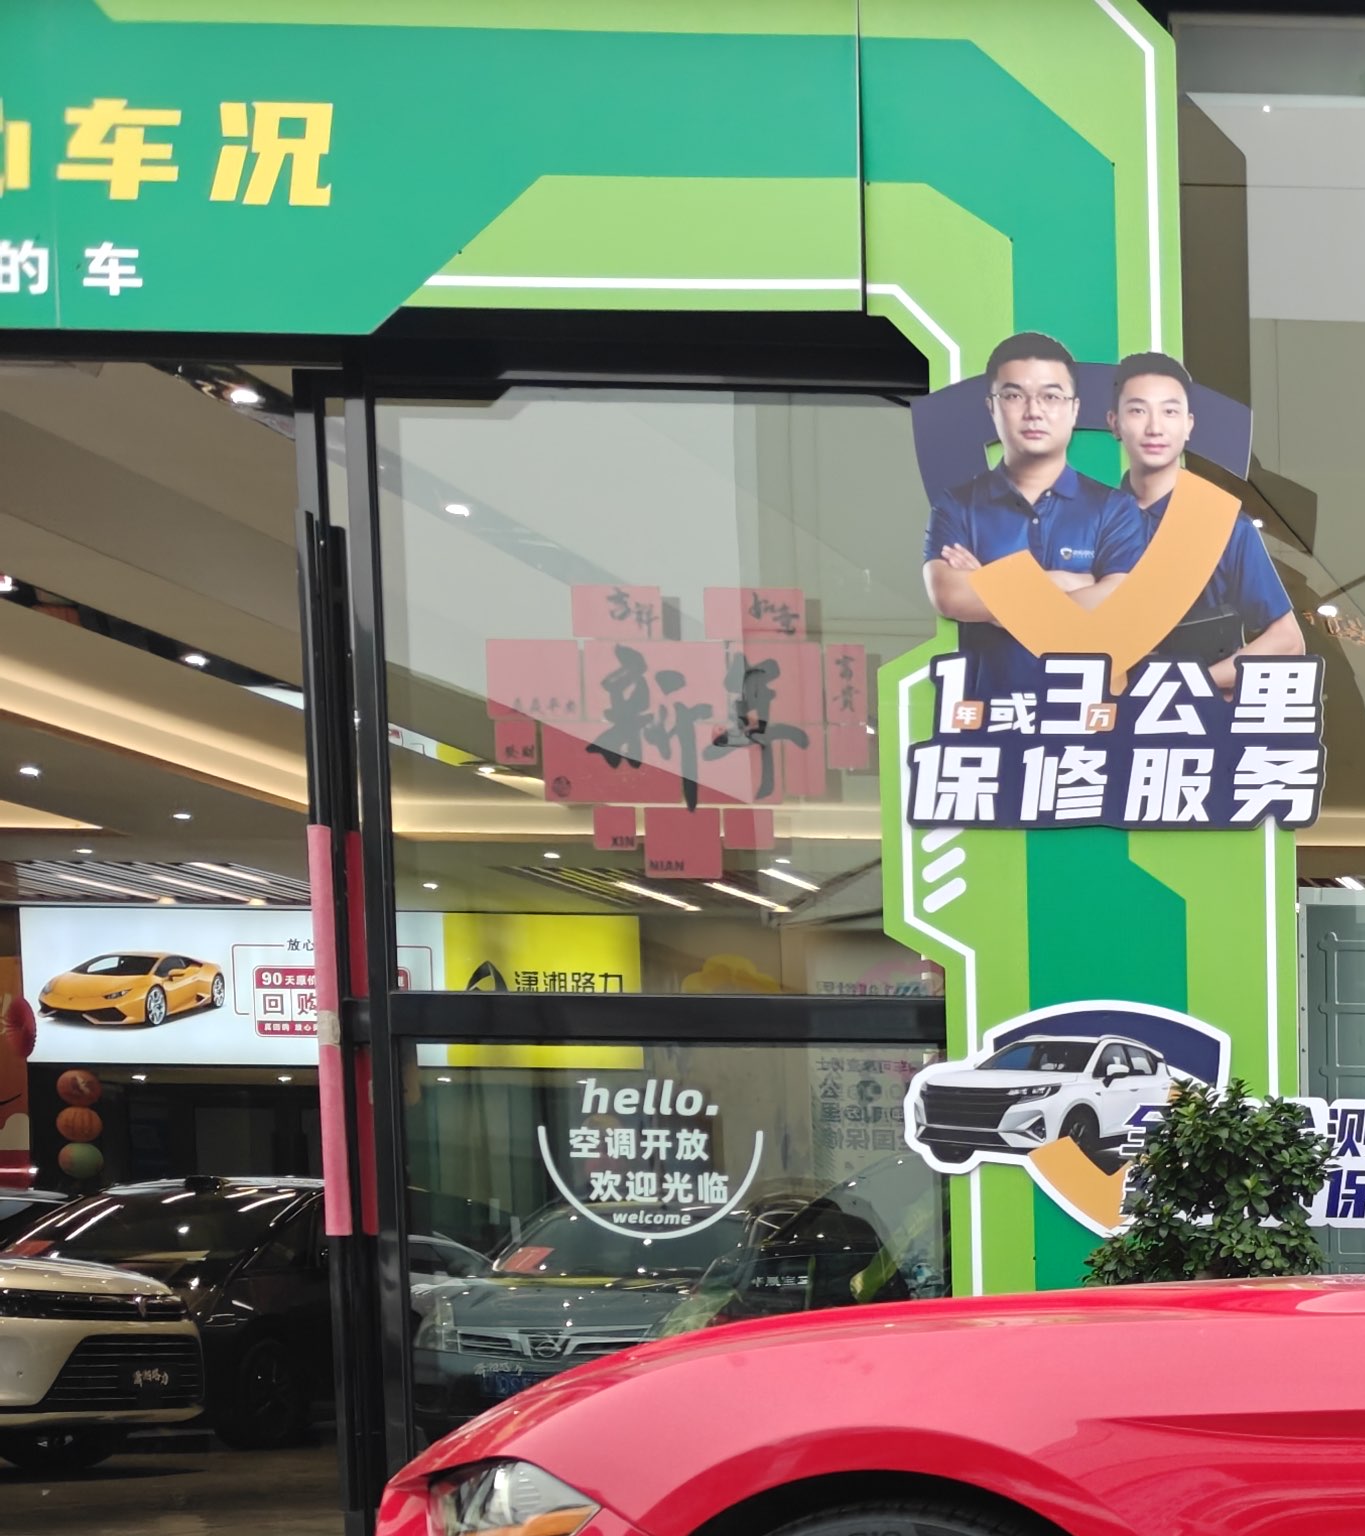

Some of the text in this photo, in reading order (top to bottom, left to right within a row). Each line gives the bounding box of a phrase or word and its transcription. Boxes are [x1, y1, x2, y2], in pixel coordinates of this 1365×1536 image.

[913, 745, 1319, 822] 保修服务
[611, 836, 635, 849] XIN
[649, 861, 685, 872] NIAN
[581, 1078, 719, 1116] hello.
[568, 1126, 710, 1161] 空调开放
[589, 1170, 730, 1204] 欢迎光临
[612, 1210, 692, 1225] welcome
